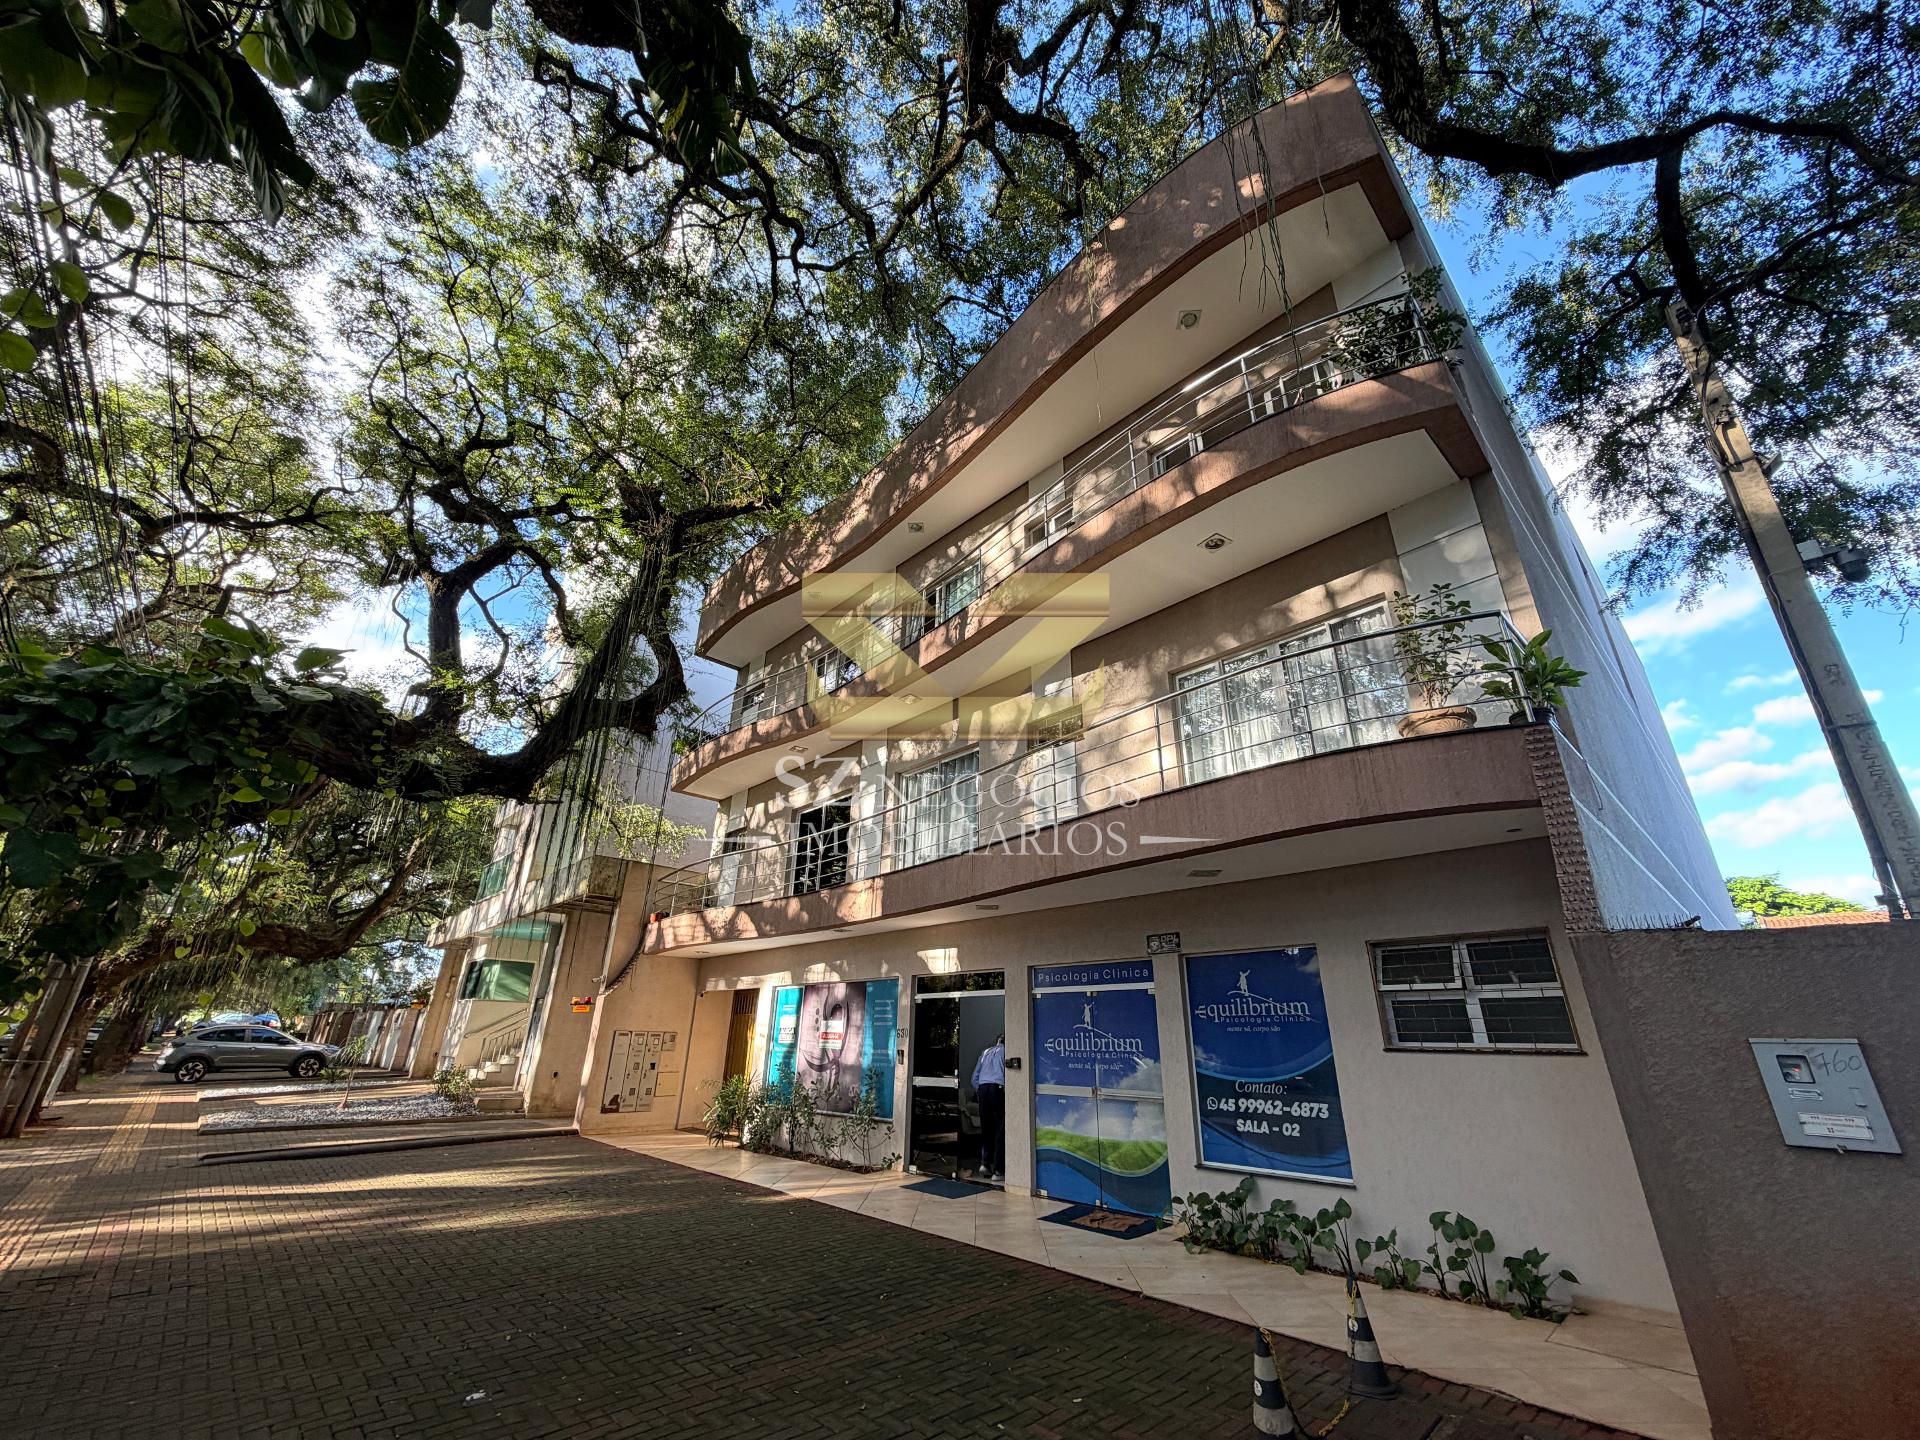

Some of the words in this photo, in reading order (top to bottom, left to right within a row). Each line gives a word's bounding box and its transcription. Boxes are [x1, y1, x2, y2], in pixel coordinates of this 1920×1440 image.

[1038, 971, 1099, 982] Psicologia
[1220, 1016, 1271, 1024] Psicologia
[1065, 1051, 1109, 1059] Psicologia
[1814, 1050, 1862, 1076] 760
[1235, 1080, 1288, 1095] Contato:
[1219, 1098, 1236, 1111] 45
[1238, 1098, 1330, 1119] 99962-6873
[1236, 1119, 1270, 1135] SALA
[1282, 1123, 1300, 1137] 02
